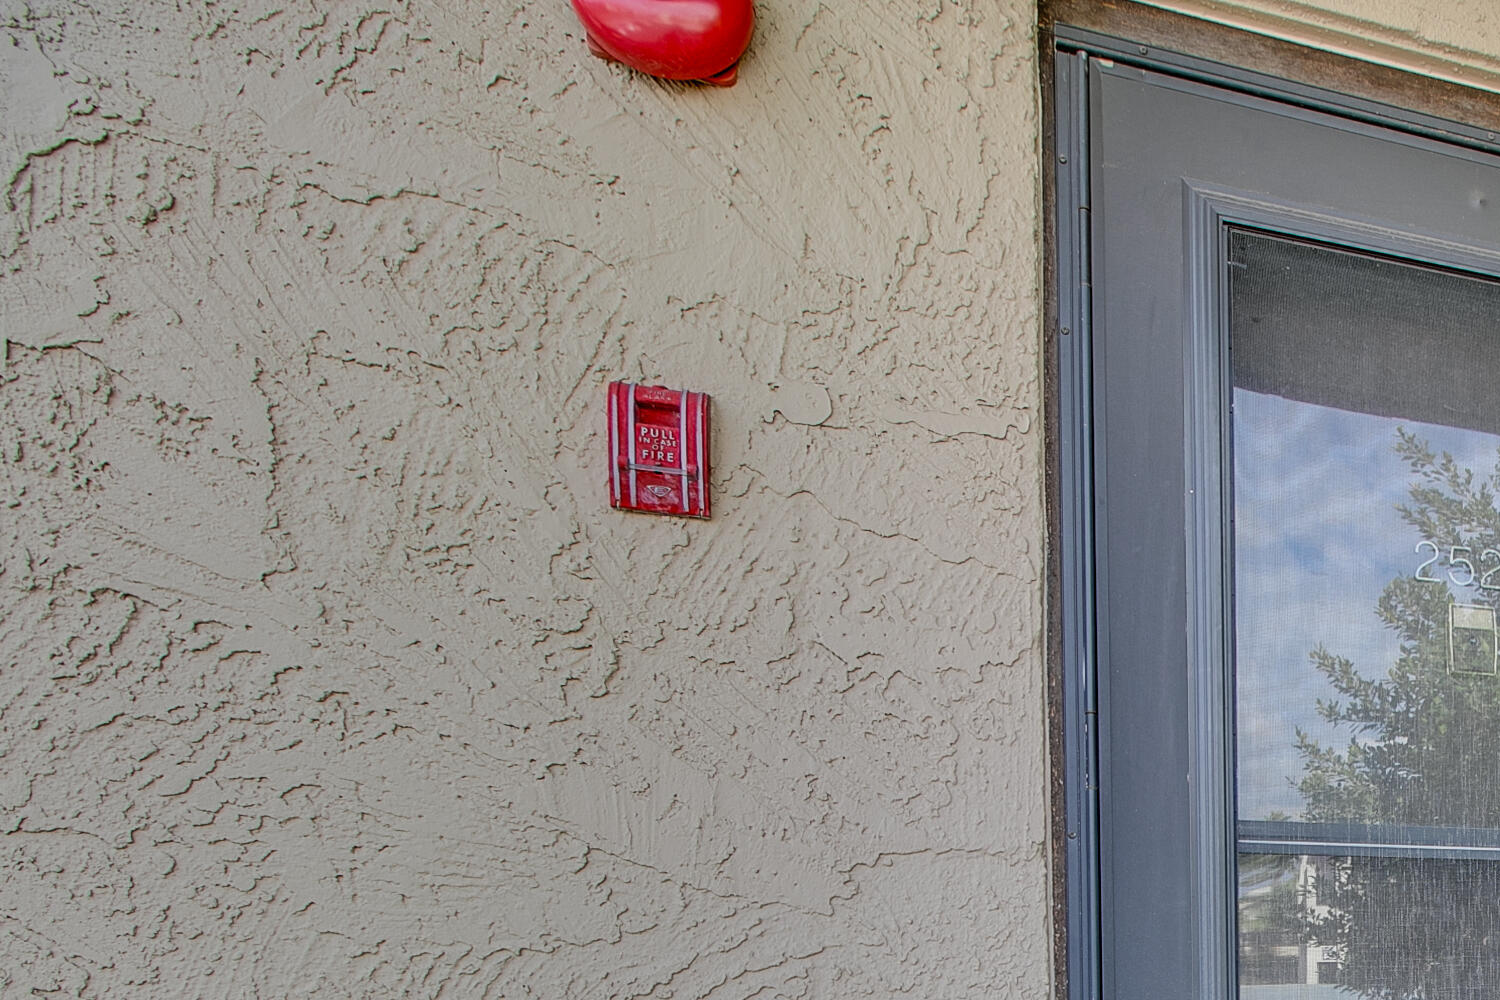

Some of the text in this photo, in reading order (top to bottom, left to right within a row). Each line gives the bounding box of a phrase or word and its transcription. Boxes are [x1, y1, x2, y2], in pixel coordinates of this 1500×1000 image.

[641, 426, 675, 440] PULL
[638, 436, 677, 447] IN CASE
[642, 449, 675, 463] FIRE
